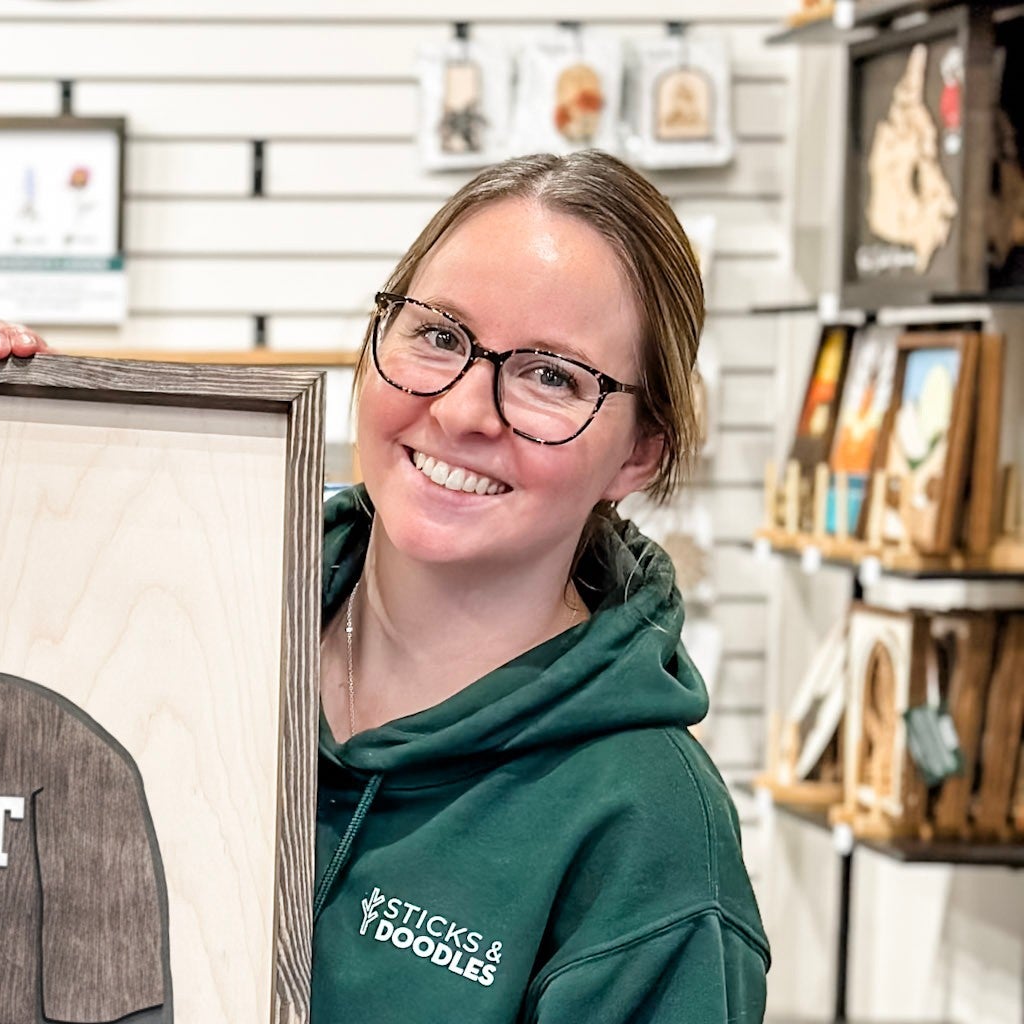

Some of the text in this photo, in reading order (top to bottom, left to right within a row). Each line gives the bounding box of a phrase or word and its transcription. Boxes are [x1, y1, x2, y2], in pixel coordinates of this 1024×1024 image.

[374, 919, 497, 986] DOODLES
[383, 897, 503, 964] STICKS &
